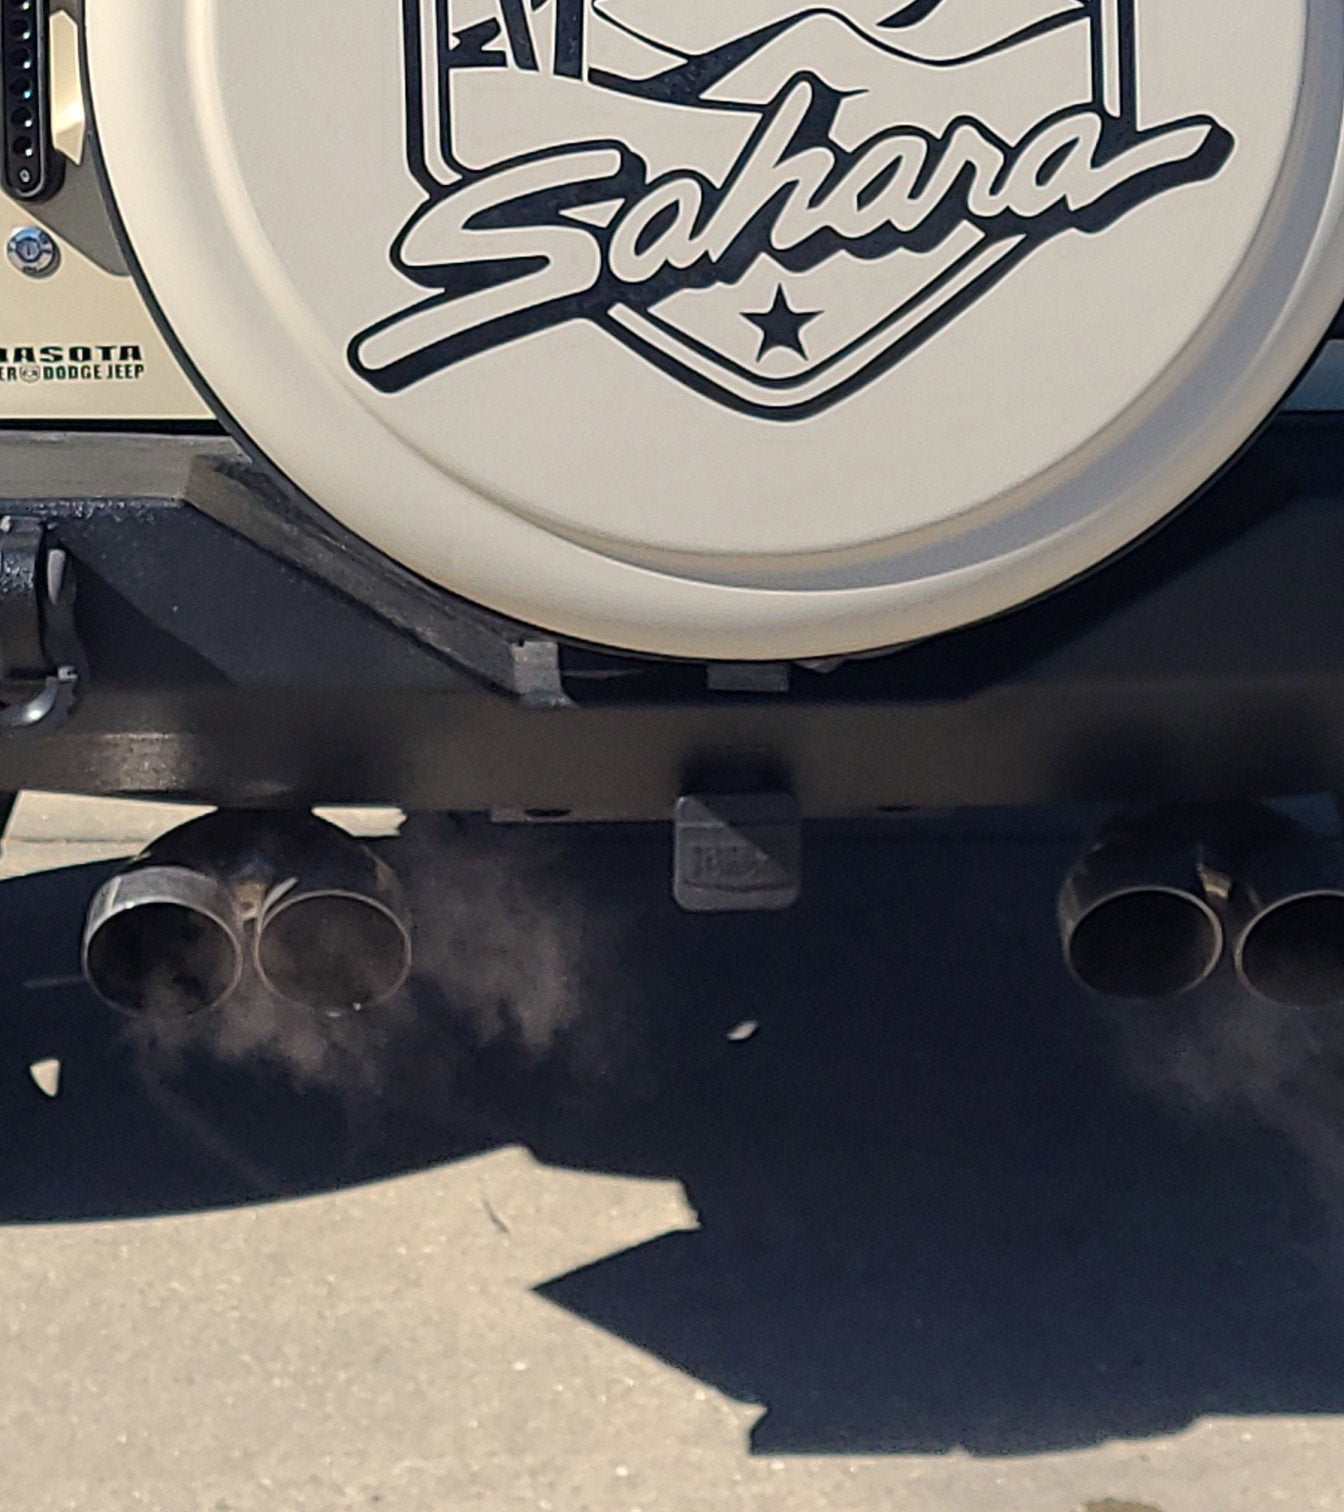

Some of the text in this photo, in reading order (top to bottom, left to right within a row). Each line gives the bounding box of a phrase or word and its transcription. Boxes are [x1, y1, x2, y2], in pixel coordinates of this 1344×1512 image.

[348, 71, 1236, 394] Sahara
[43, 364, 102, 380] DODGE
[106, 363, 145, 380] JEEP
